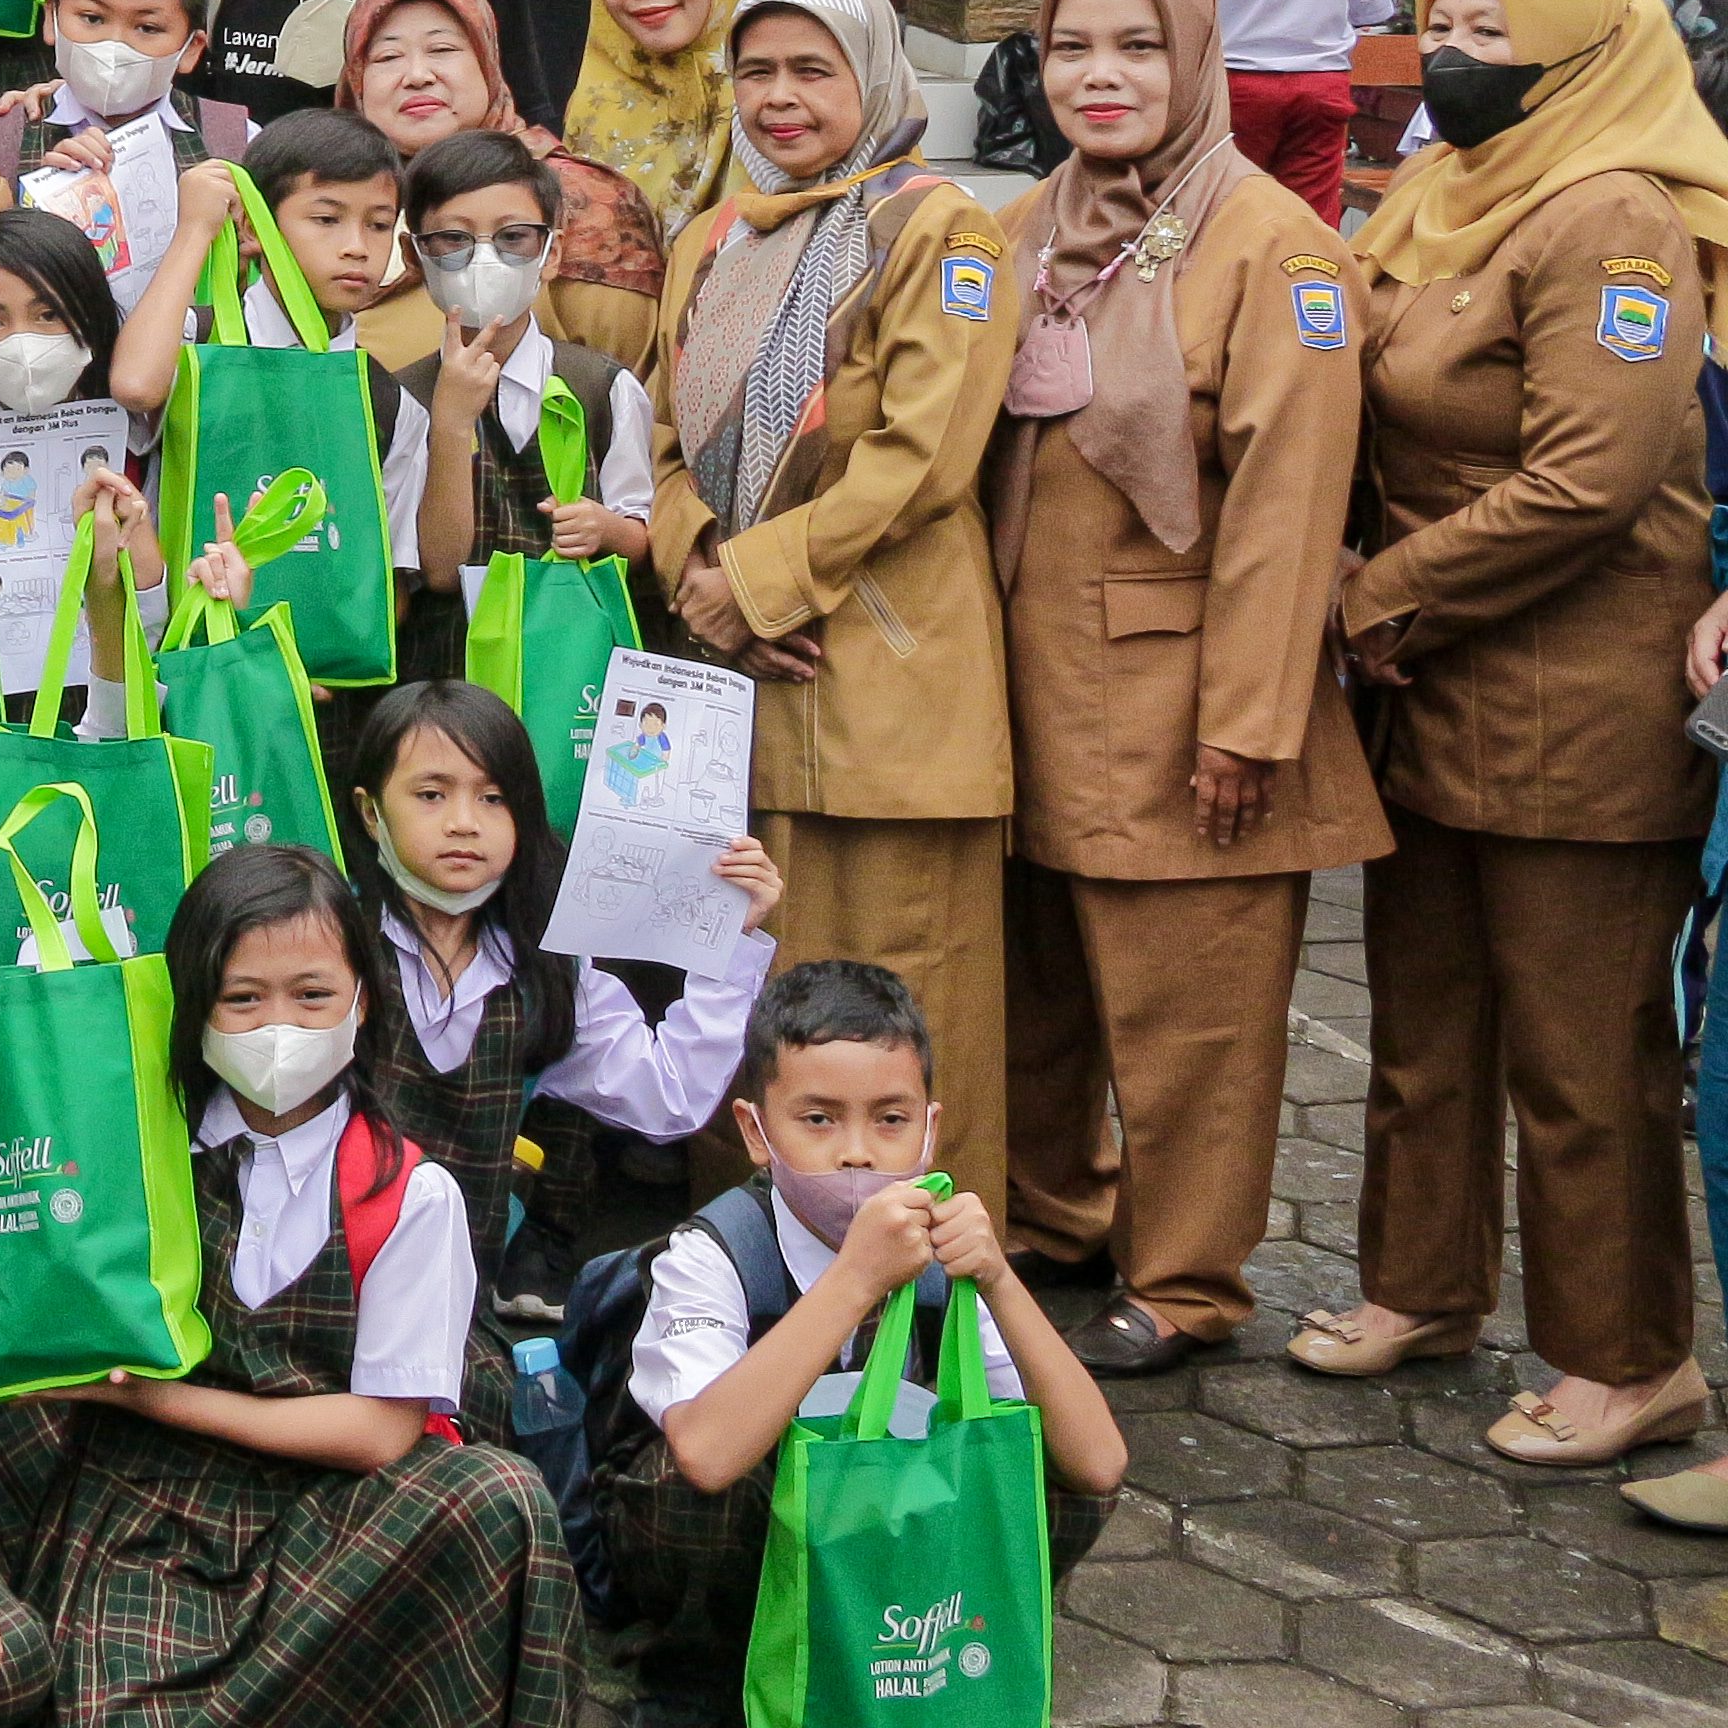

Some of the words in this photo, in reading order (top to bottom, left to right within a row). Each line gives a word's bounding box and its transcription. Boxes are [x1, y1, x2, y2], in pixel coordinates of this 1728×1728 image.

[60, 408, 84, 418] Bebas
[86, 404, 118, 416] Dengue
[870, 1660, 902, 1676] LOTION
[903, 1659, 928, 1672] ANTI
[875, 1678, 922, 1699] HALAL
